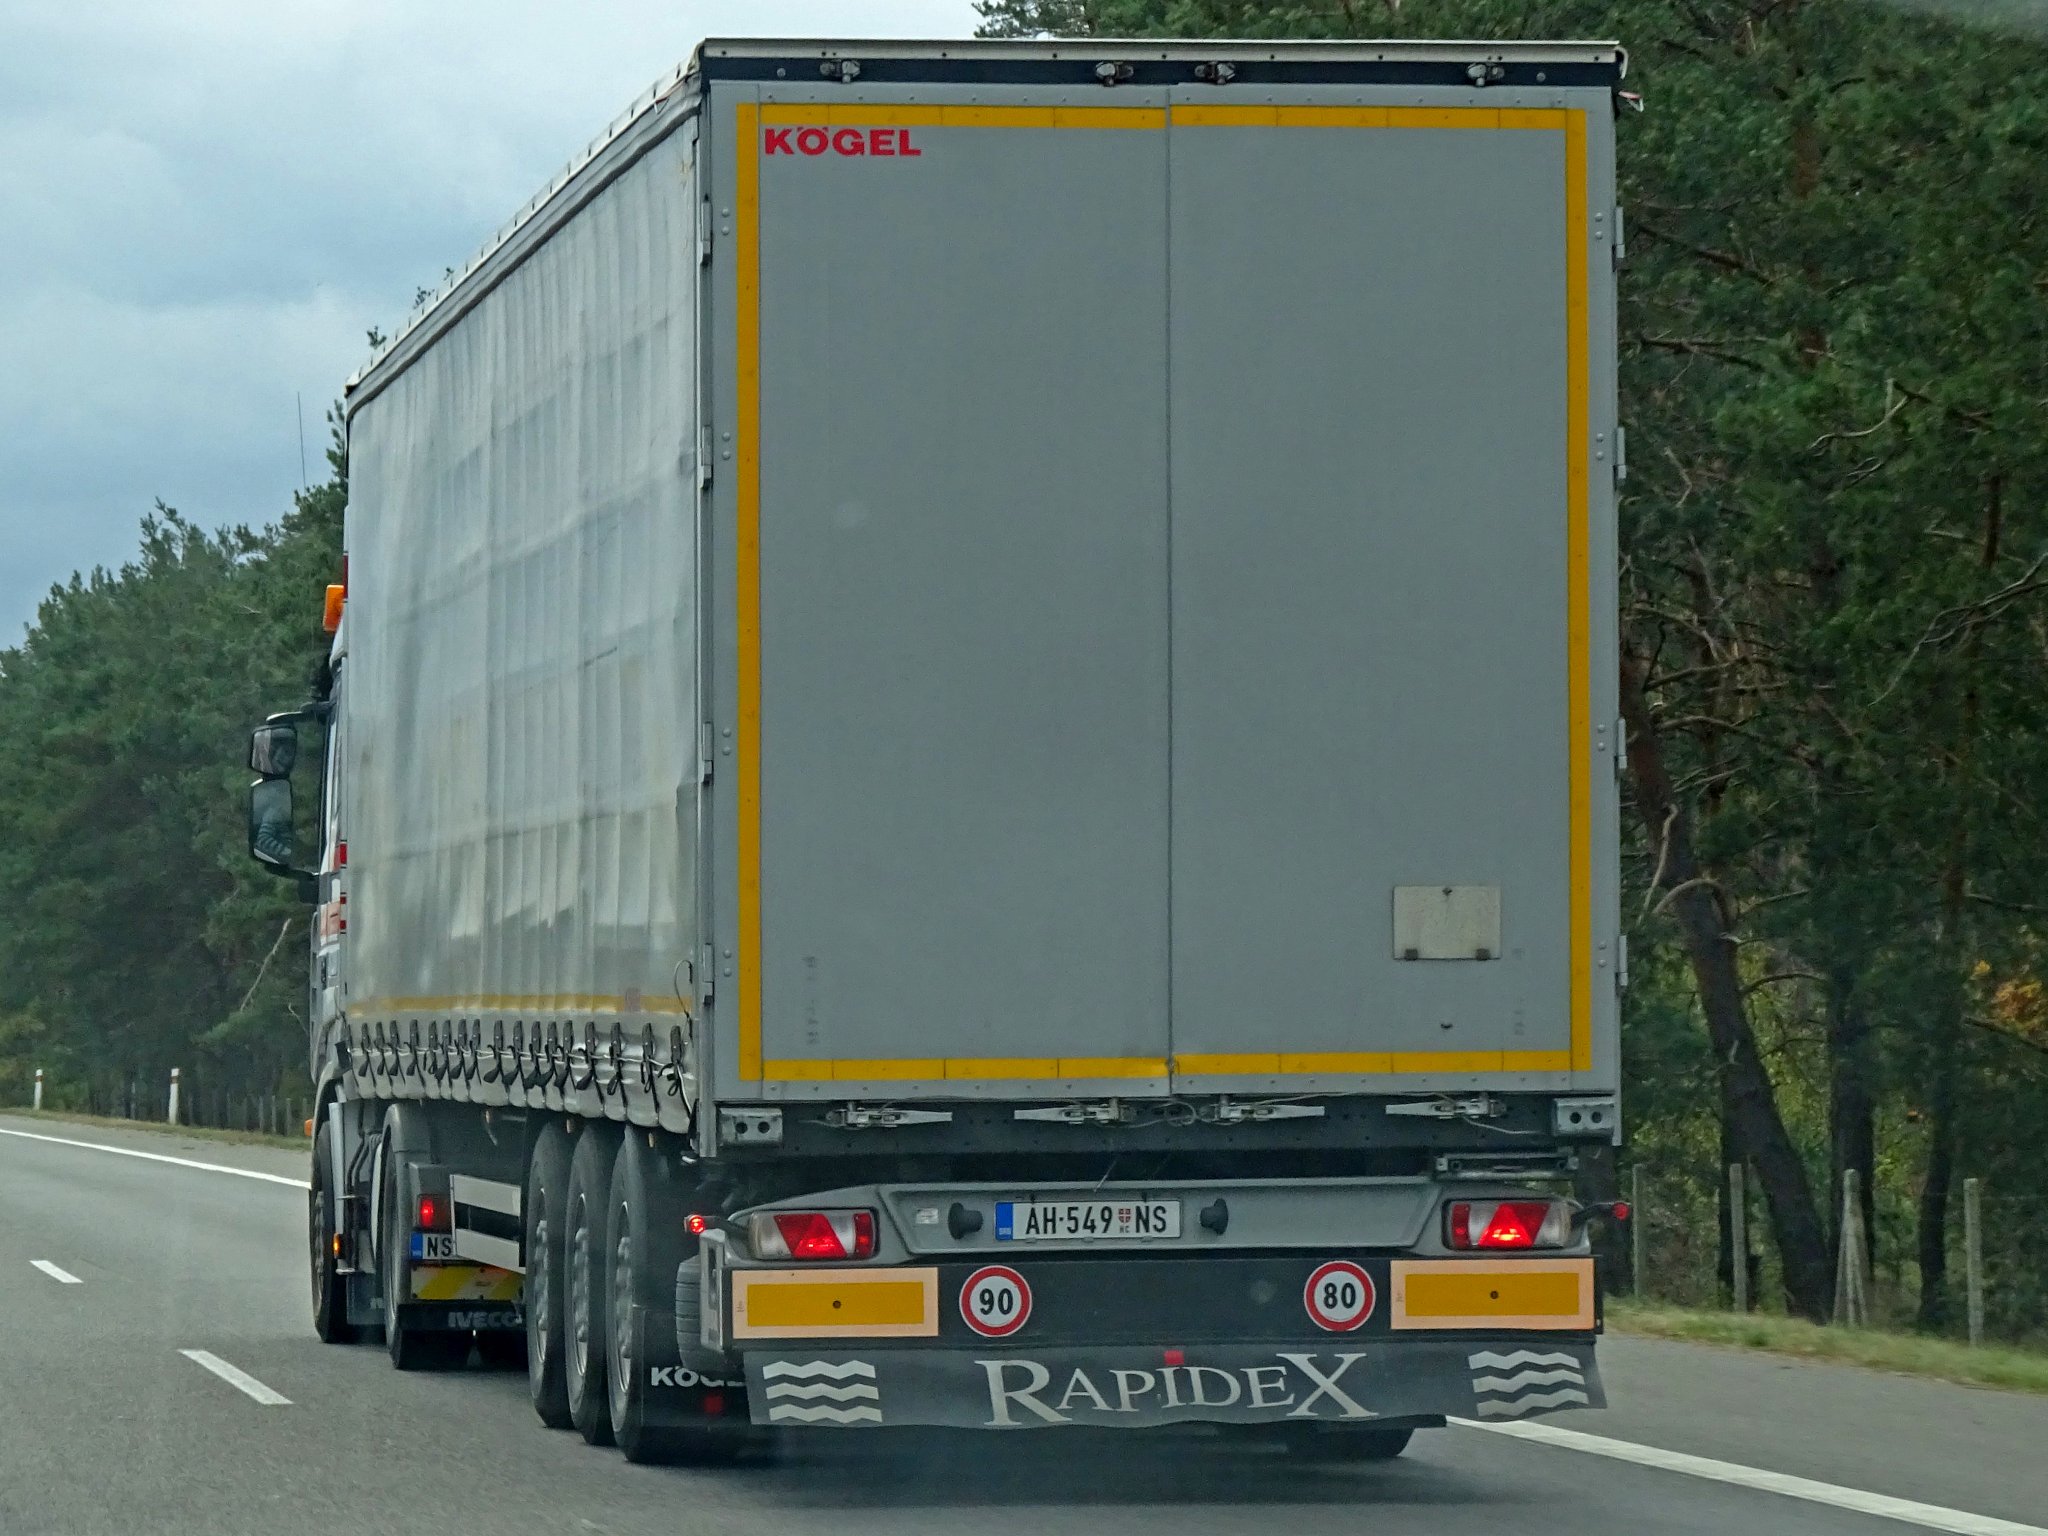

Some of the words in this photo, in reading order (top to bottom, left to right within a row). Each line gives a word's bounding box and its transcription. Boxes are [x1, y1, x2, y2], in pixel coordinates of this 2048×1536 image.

[765, 127, 922, 156] KÖGEL
[1135, 1205, 1167, 1233] NS
[427, 1236, 452, 1257] NS
[980, 1288, 1013, 1315] 90
[1323, 1282, 1356, 1309] 80
